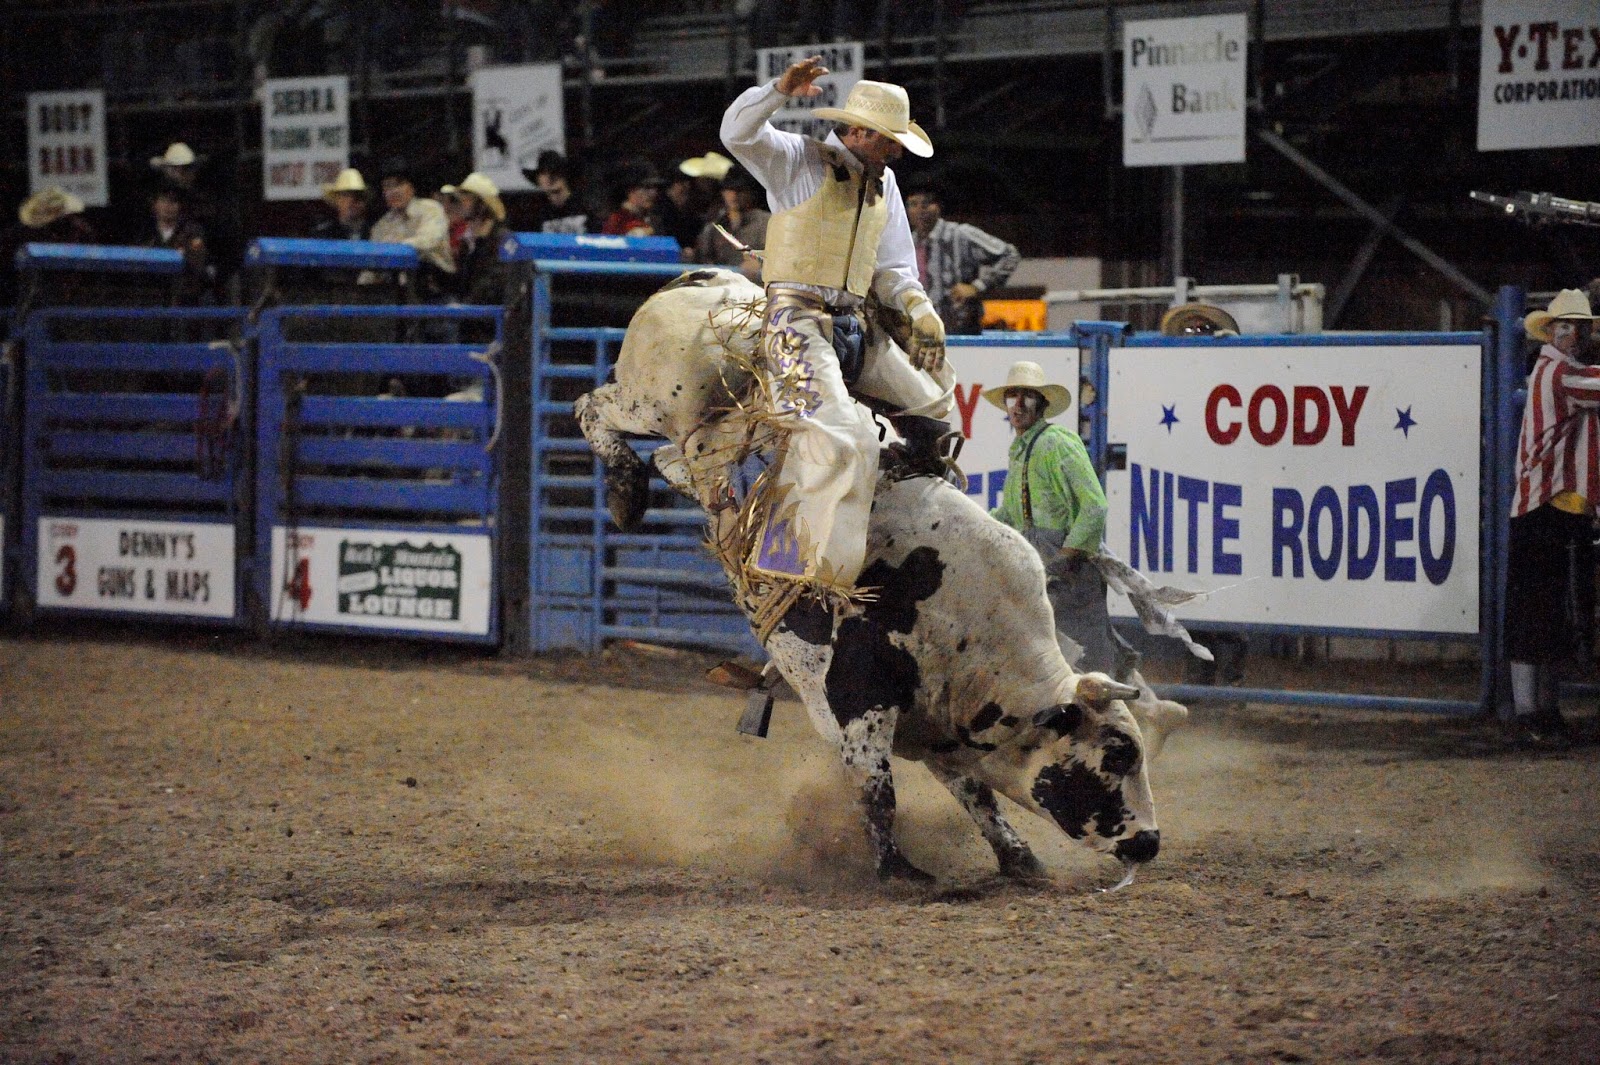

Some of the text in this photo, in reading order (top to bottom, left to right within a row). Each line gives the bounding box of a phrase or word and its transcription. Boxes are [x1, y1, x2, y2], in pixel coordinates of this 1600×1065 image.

[1131, 32, 1239, 67] Pinnacle
[1171, 79, 1237, 114] Bank
[1493, 77, 1600, 104] CORPORATIO
[1204, 383, 1370, 446] CODY
[1129, 462, 1457, 586] NITE RODEO
[119, 532, 195, 559] DENNY'S
[54, 544, 78, 597] 3
[97, 566, 210, 602] GUNS & MAPS
[378, 566, 458, 589] LIQUOR
[349, 595, 453, 618] LOUNGE
